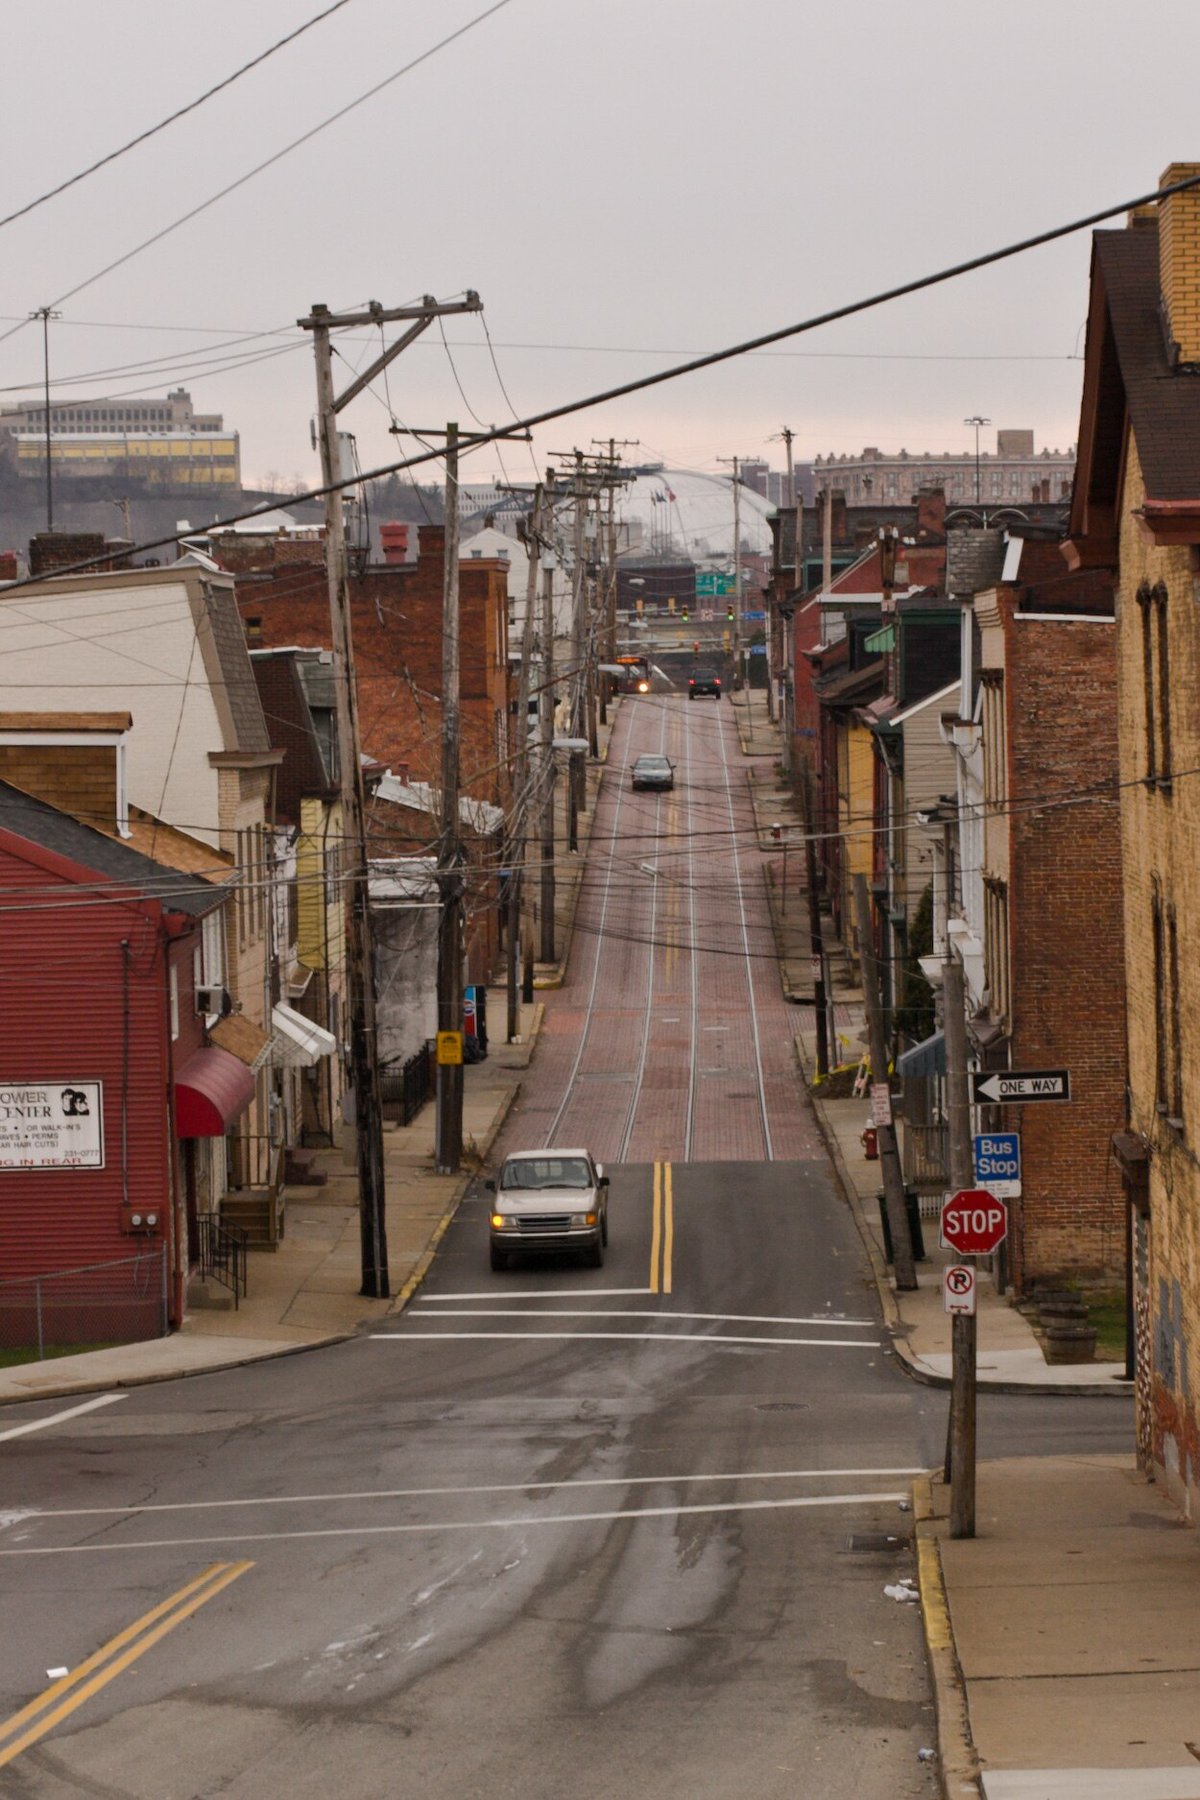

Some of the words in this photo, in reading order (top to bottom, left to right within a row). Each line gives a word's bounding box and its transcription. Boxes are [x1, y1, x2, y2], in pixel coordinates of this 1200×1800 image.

[1000, 1081, 1025, 1093] ONE
[1031, 1079, 1058, 1092] WAY
[0, 1092, 47, 1104] OWER
[64, 1149, 99, 1157] 231-0777
[981, 1139, 1013, 1155] Bus
[978, 1158, 1017, 1176] Stop
[946, 1209, 1002, 1235] STOP
